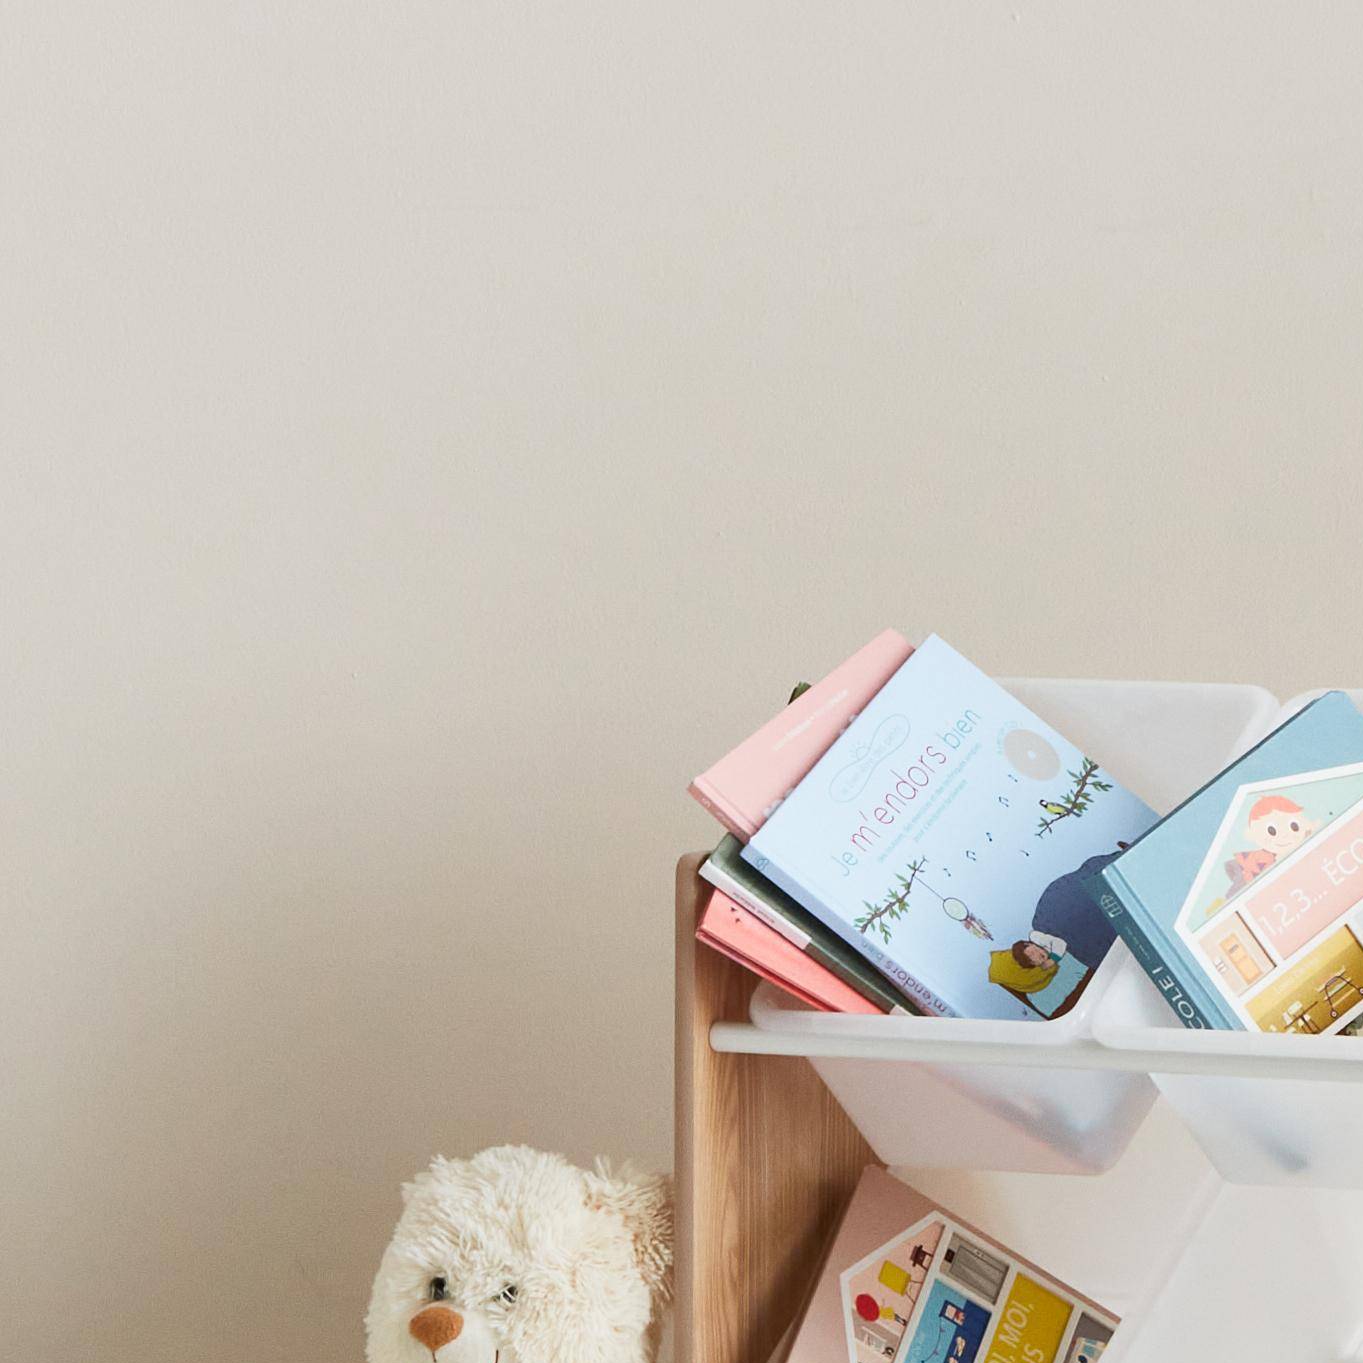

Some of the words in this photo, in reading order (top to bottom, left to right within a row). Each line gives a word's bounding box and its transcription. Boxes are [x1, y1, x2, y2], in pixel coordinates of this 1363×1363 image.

[831, 851, 859, 877] Je
[850, 745, 947, 852] m'endors
[936, 708, 982, 751] bien
[998, 1299, 1036, 1350] MOI,
